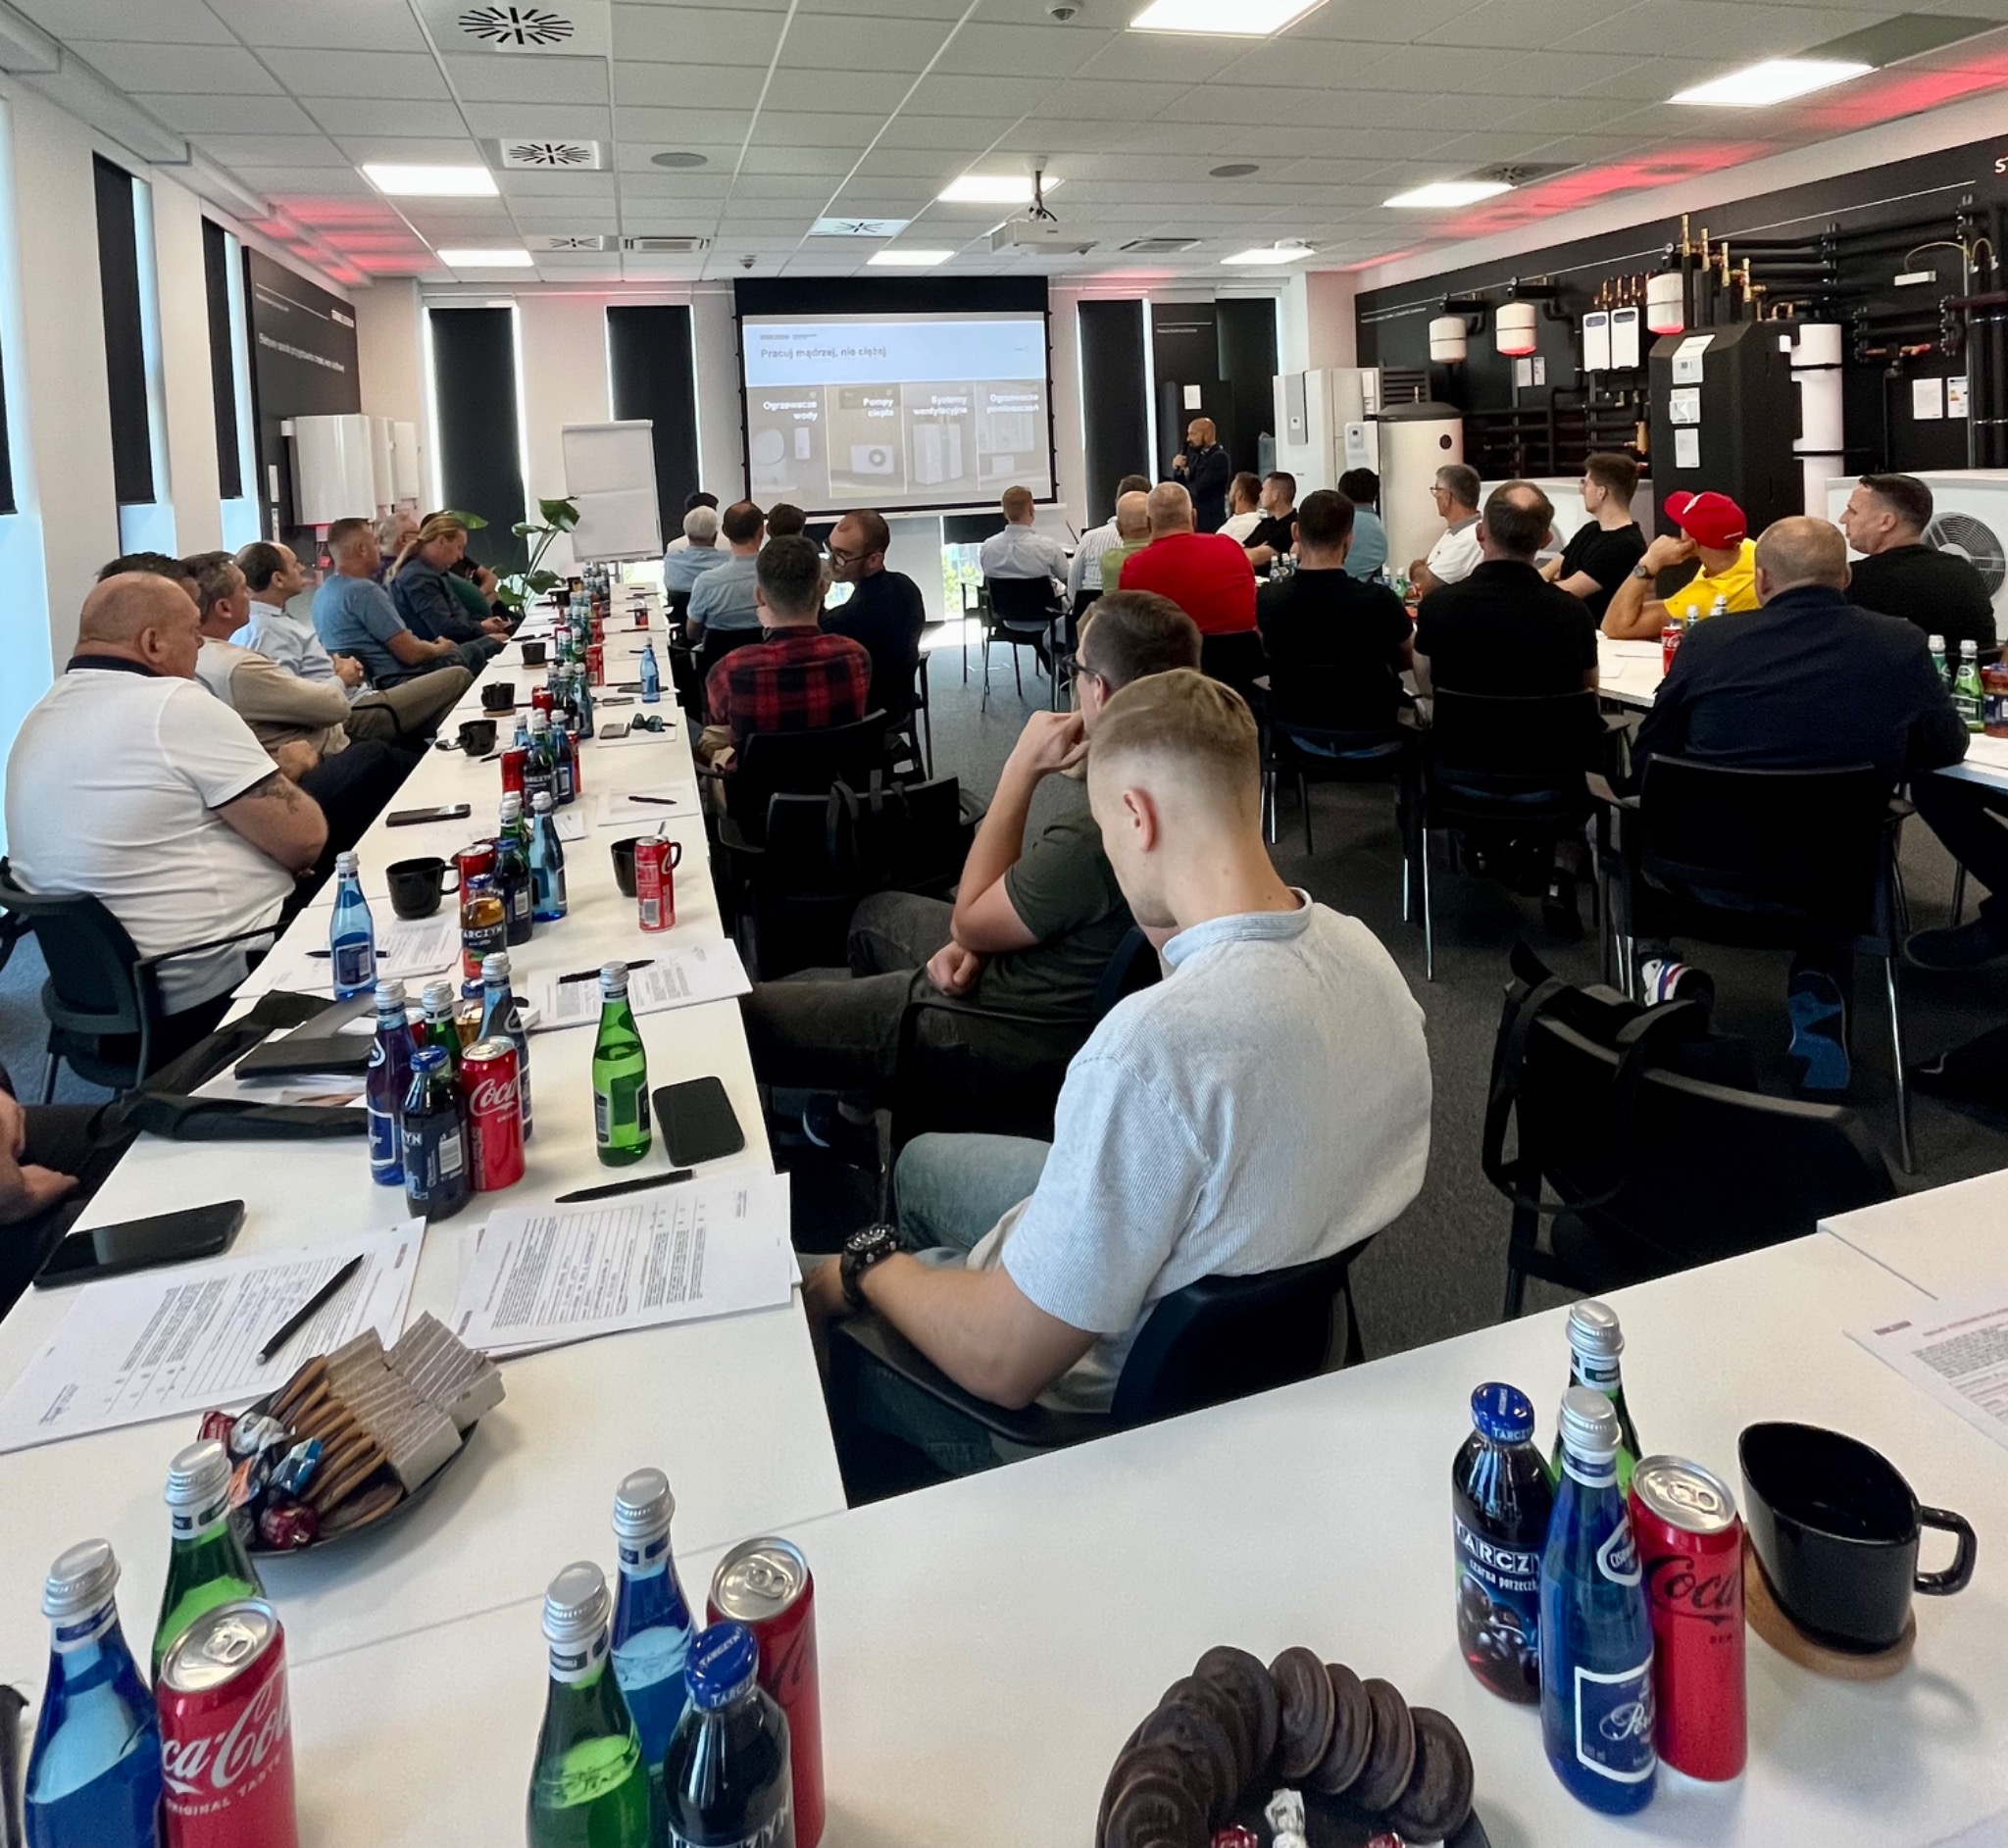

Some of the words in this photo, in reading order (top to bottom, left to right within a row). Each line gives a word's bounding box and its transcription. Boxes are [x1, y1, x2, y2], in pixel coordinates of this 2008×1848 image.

[760, 348, 793, 360] Pracuj
[840, 347, 856, 357] nie
[793, 411, 818, 422] wody
[462, 924, 504, 939] ARCZYN
[1454, 1515, 1540, 1574] TARCZ
[1470, 1559, 1497, 1584] czarna
[1498, 1576, 1538, 1591] porzeczk
